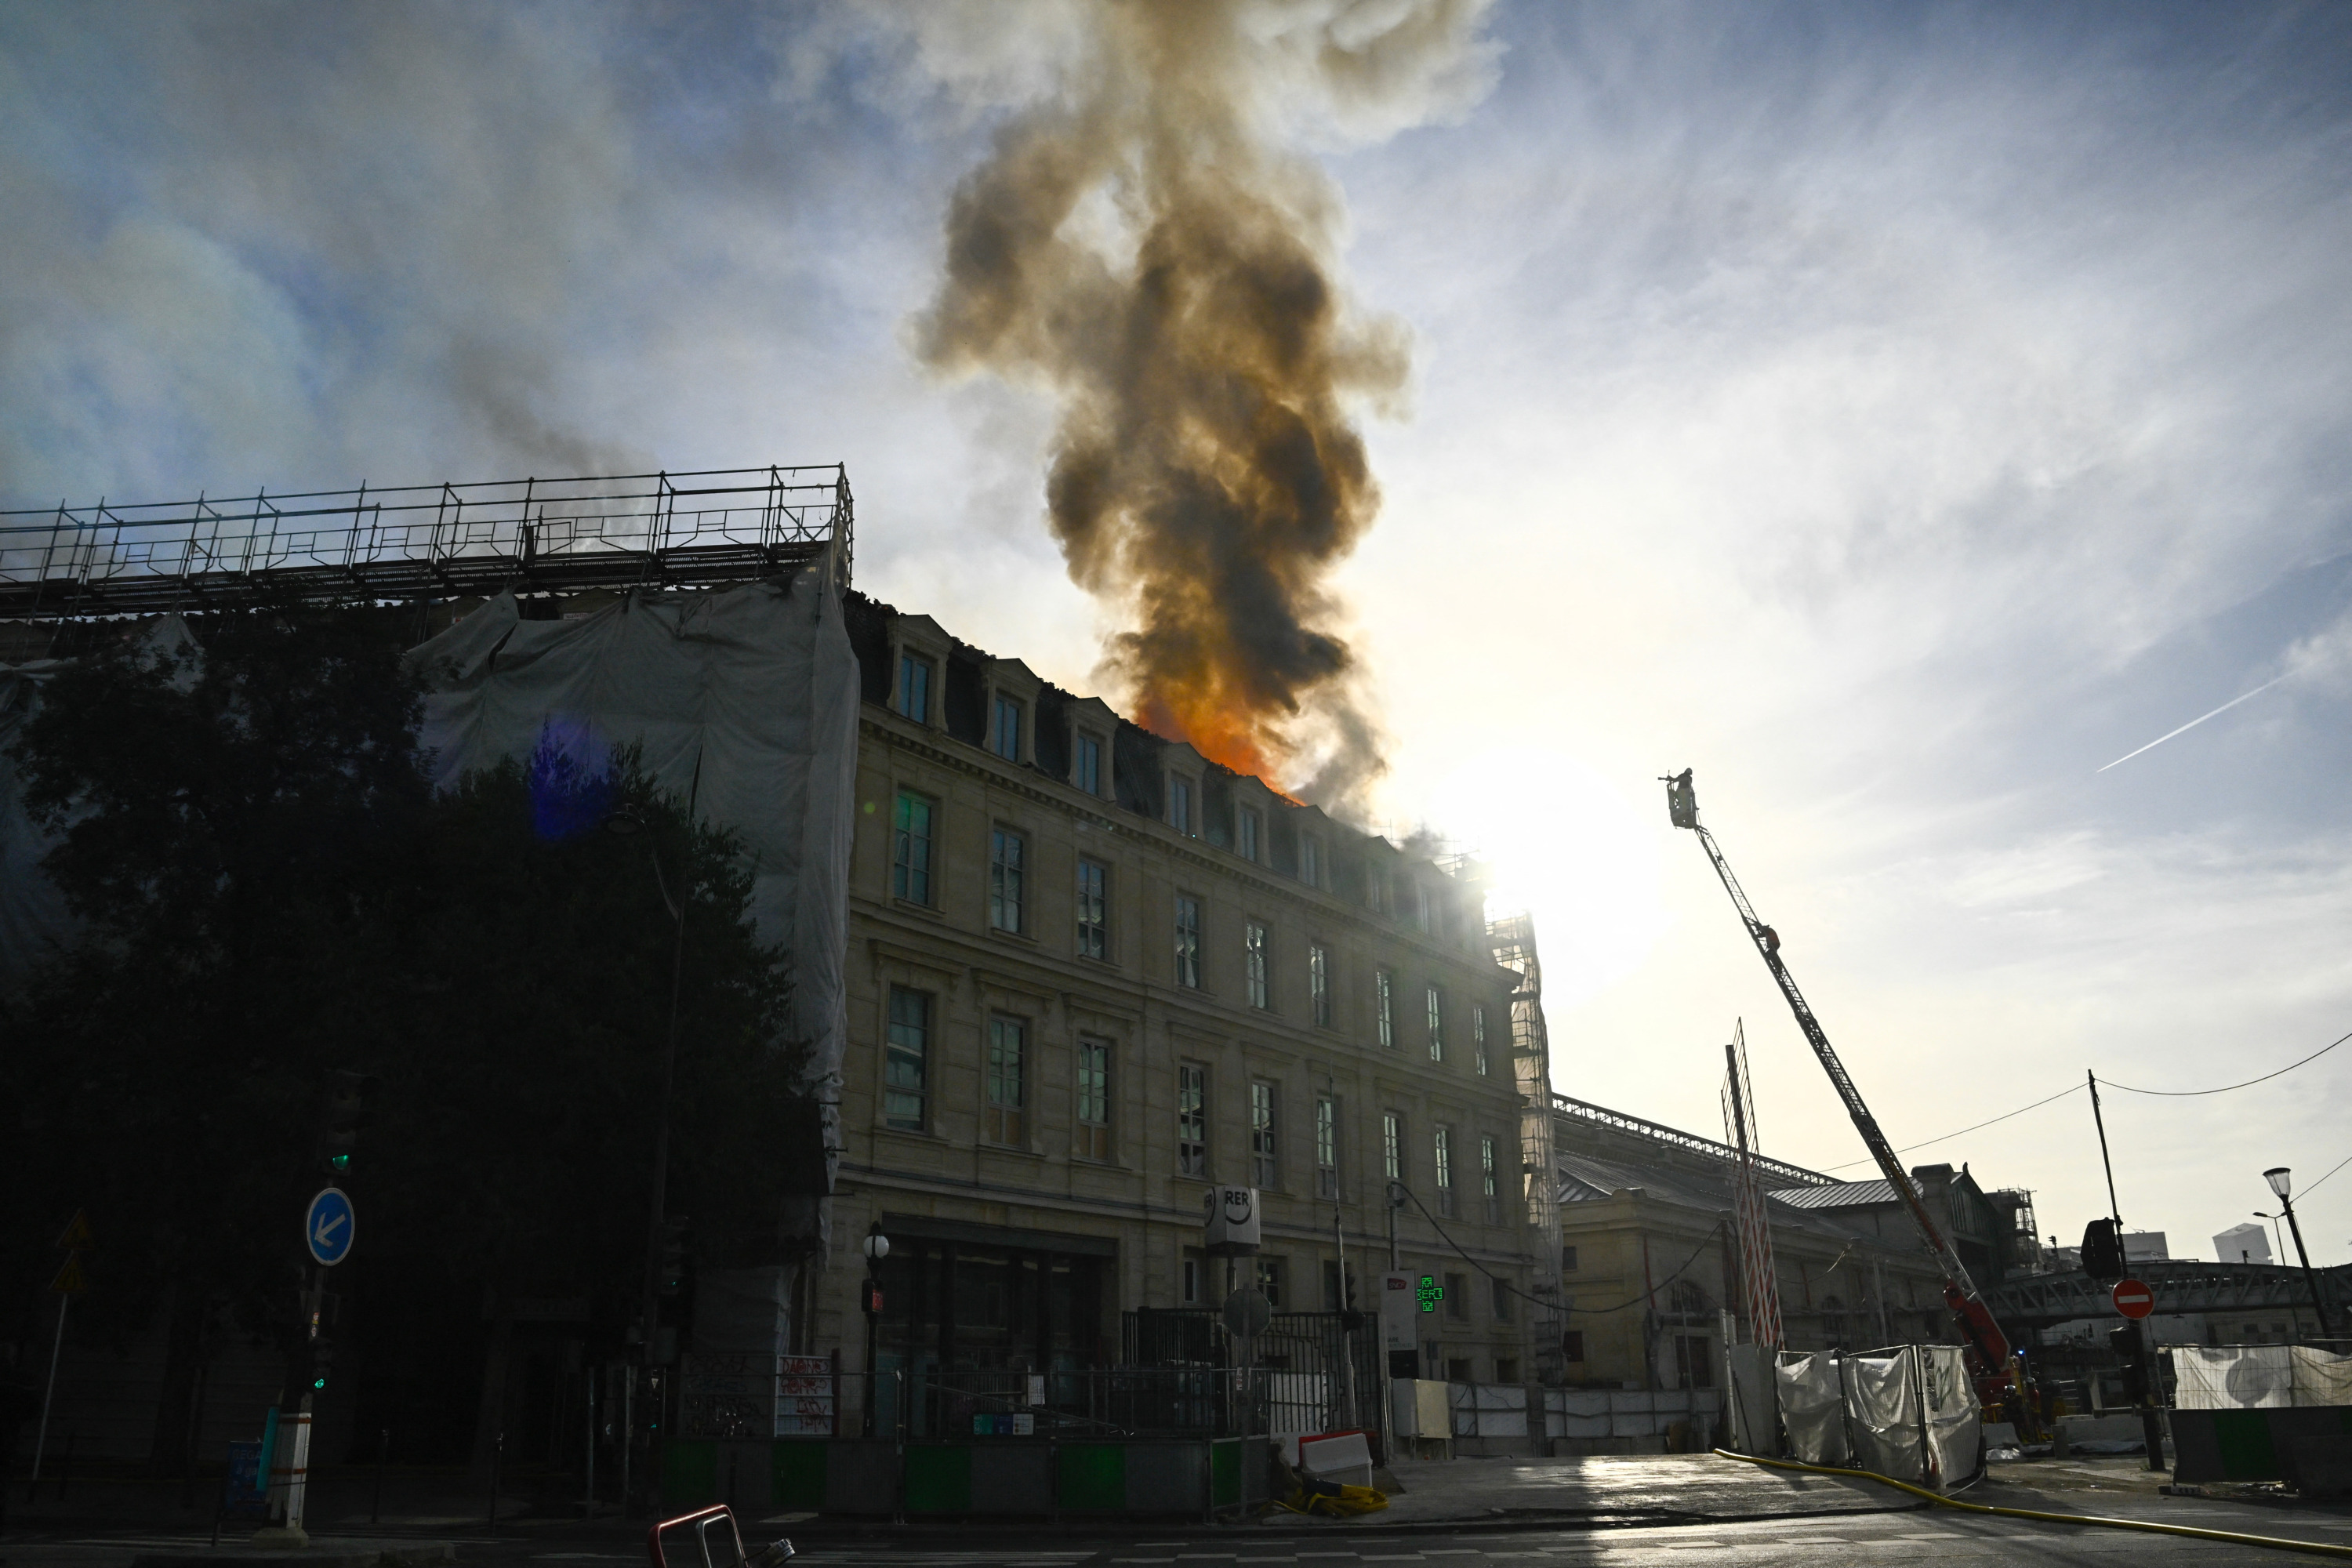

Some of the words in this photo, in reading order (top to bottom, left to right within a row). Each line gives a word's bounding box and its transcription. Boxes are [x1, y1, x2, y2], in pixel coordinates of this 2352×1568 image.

[1225, 1190, 1249, 1207] RER
[232, 1448, 262, 1461] REGA
[245, 1467, 257, 1479] ga
